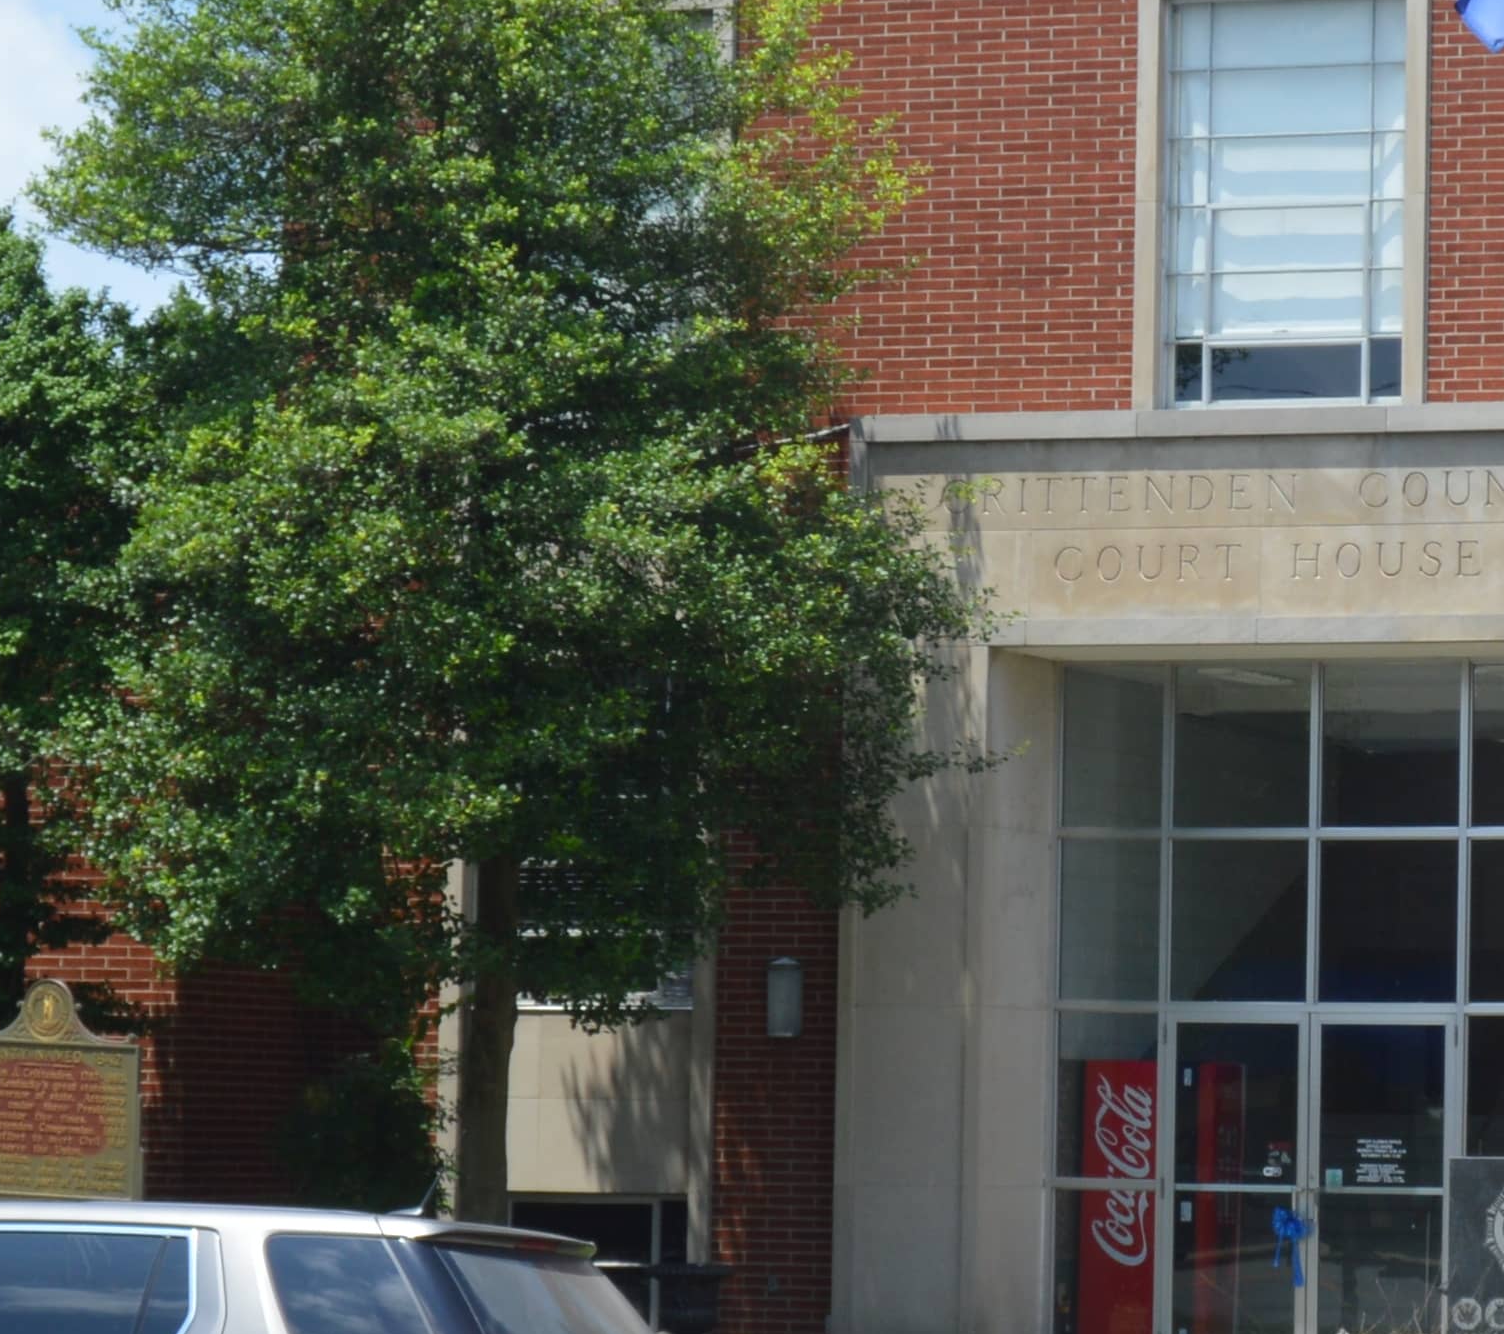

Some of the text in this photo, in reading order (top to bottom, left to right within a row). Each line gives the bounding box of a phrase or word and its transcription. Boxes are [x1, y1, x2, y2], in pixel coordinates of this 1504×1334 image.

[941, 473, 1297, 515] CRITTENDEN
[1054, 540, 1482, 583] COURT HOUSE
